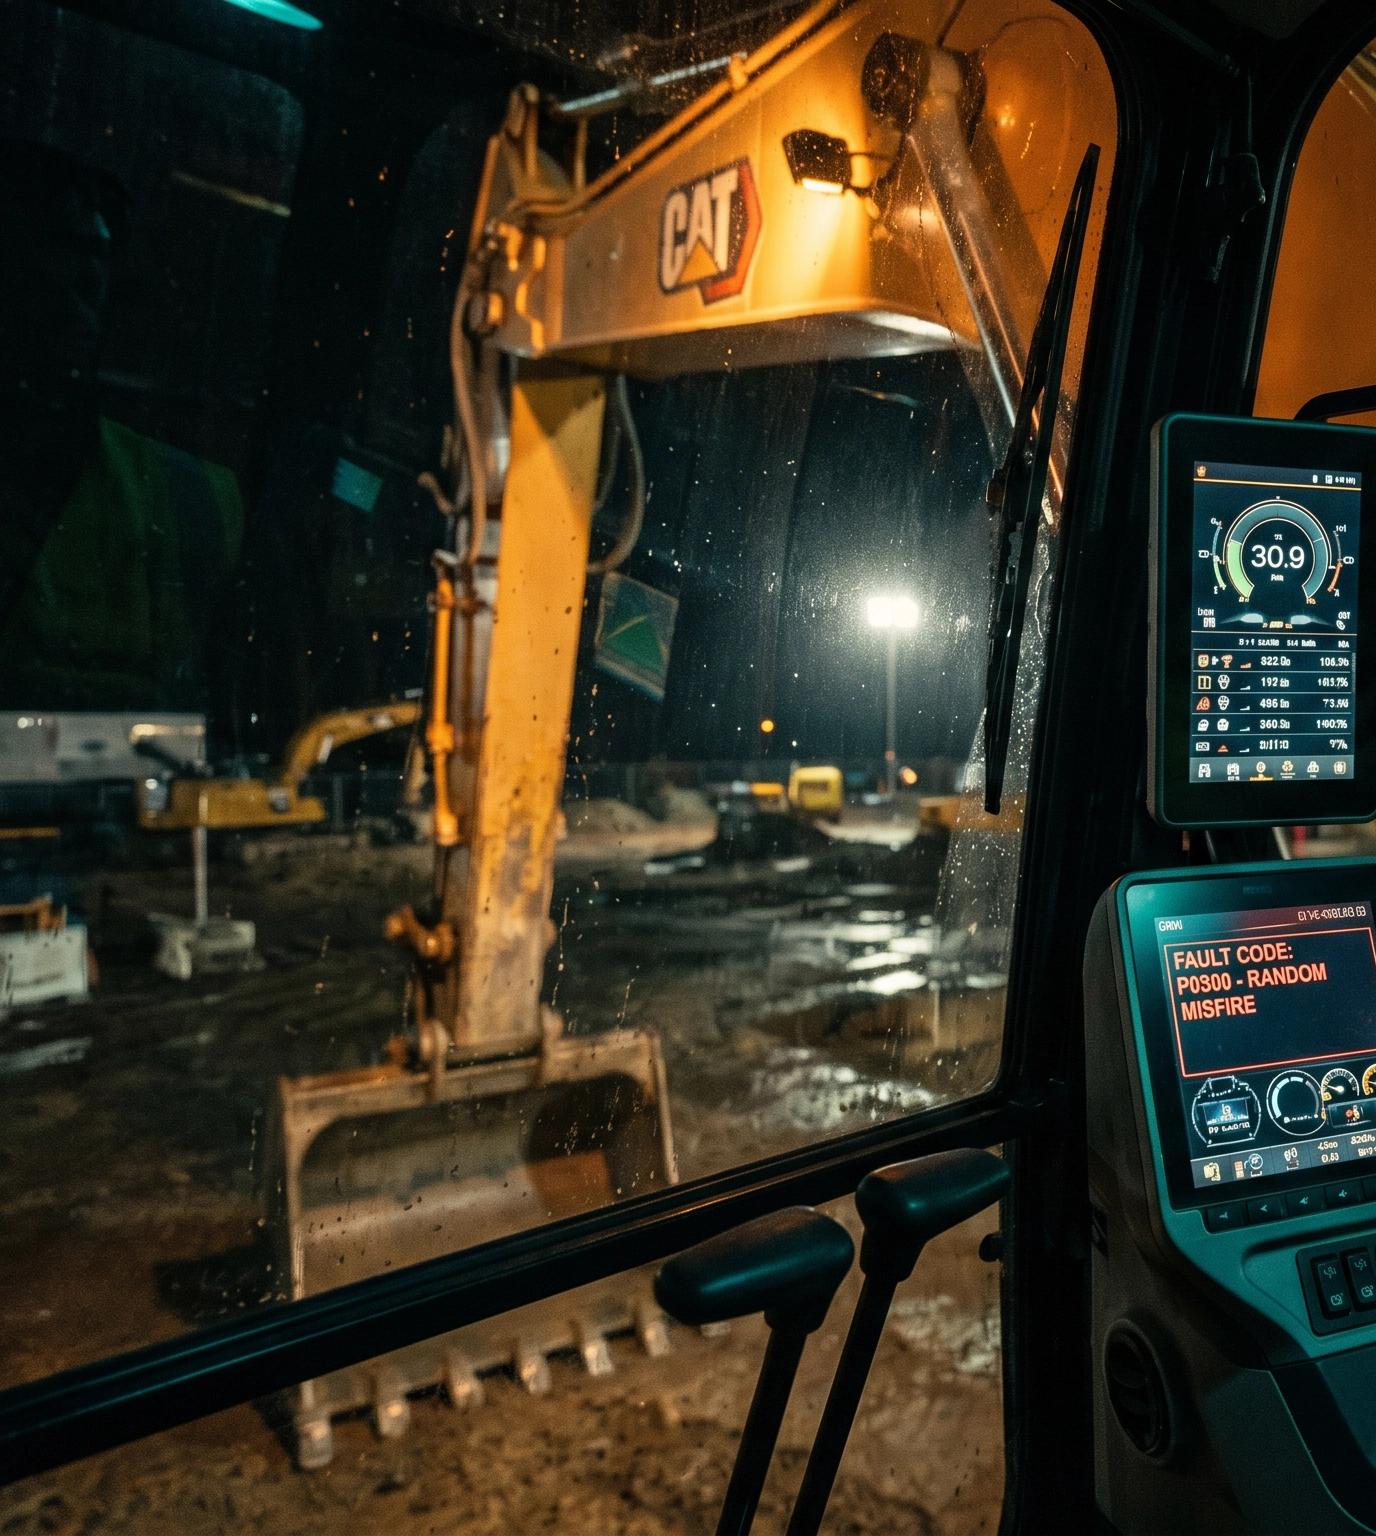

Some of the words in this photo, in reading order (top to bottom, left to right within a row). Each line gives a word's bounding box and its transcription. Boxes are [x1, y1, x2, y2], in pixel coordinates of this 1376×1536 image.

[661, 166, 739, 290] CAT
[1251, 544, 1305, 569] 30.9
[1173, 947, 1231, 970] FAULT
[1236, 941, 1294, 964] CODE:
[1247, 963, 1327, 988] RANDOM
[1181, 995, 1257, 1021] MISFIRE
